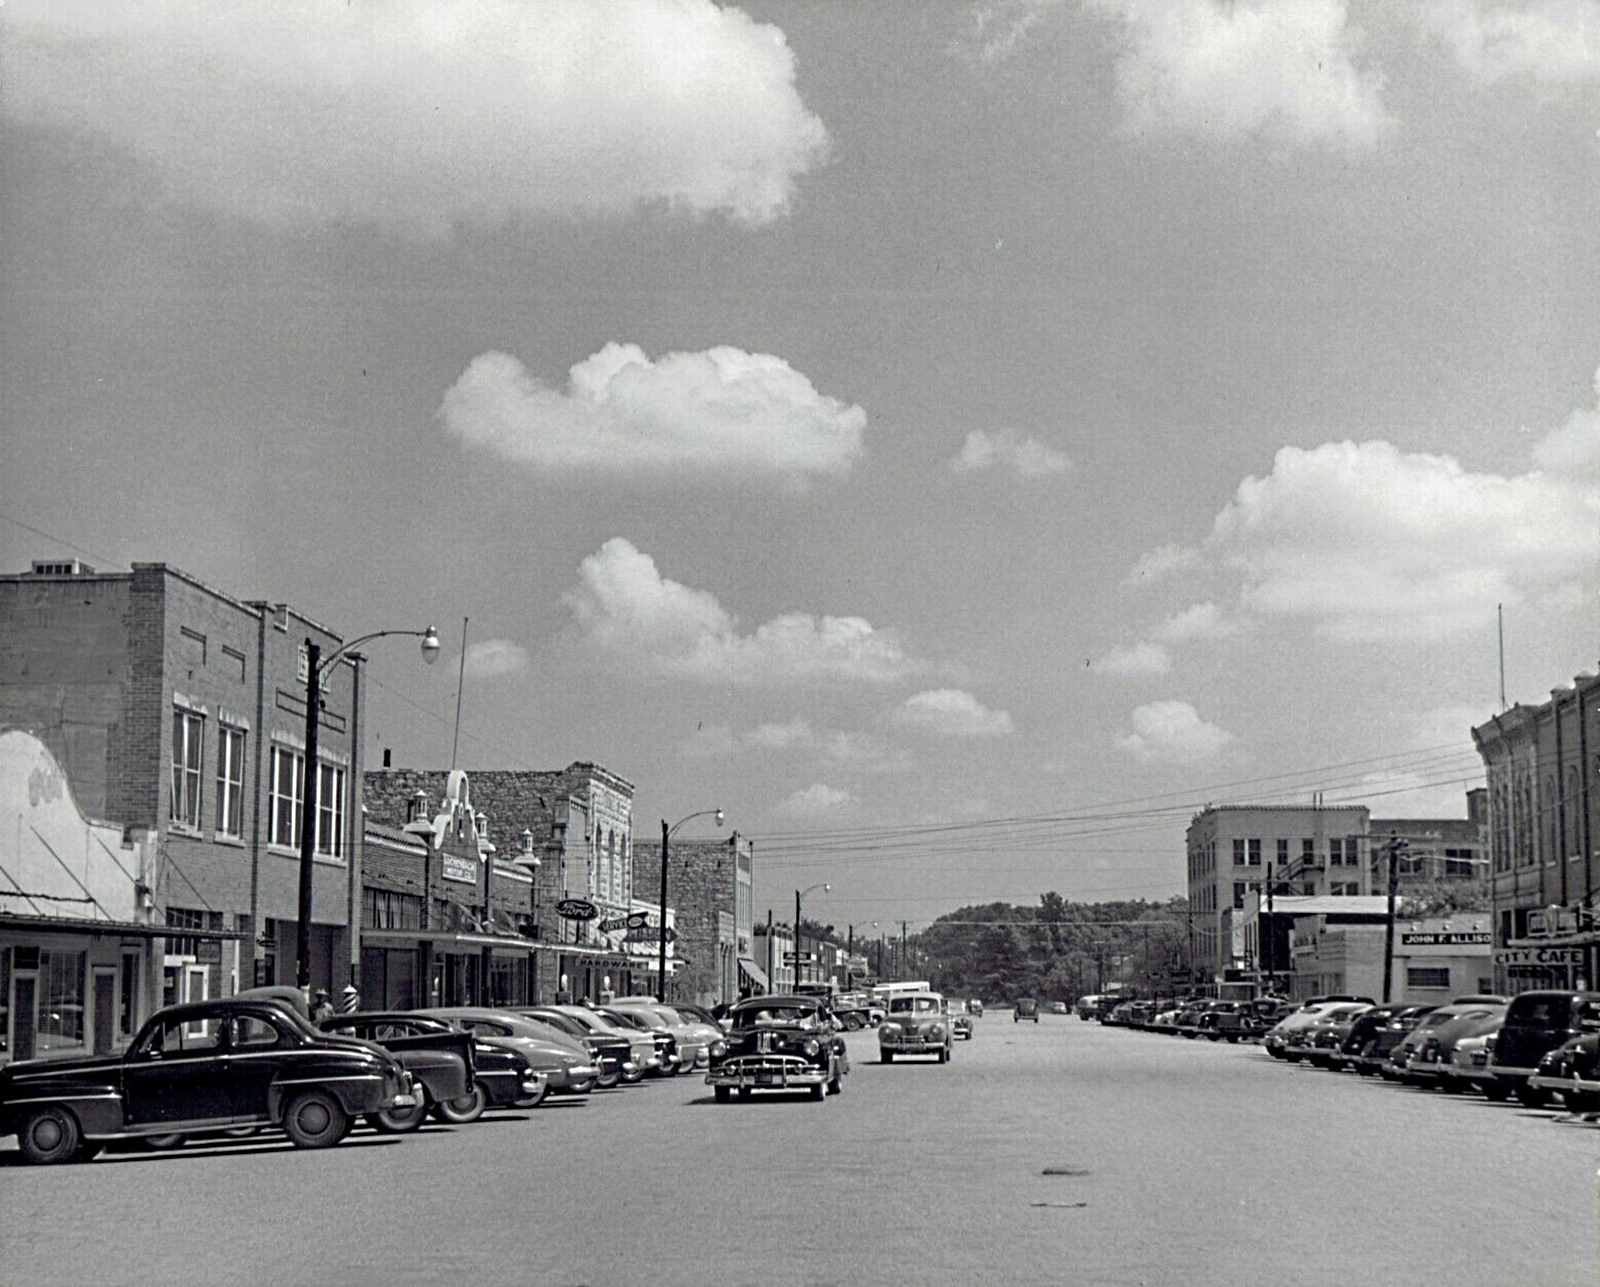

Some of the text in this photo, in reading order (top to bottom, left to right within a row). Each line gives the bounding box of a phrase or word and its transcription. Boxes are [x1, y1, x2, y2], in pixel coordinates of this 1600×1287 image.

[561, 903, 593, 917] Ford
[1405, 935, 1434, 944] JOHN
[1496, 950, 1583, 964] CITY CAFE
[581, 959, 644, 969] HARDWARE
